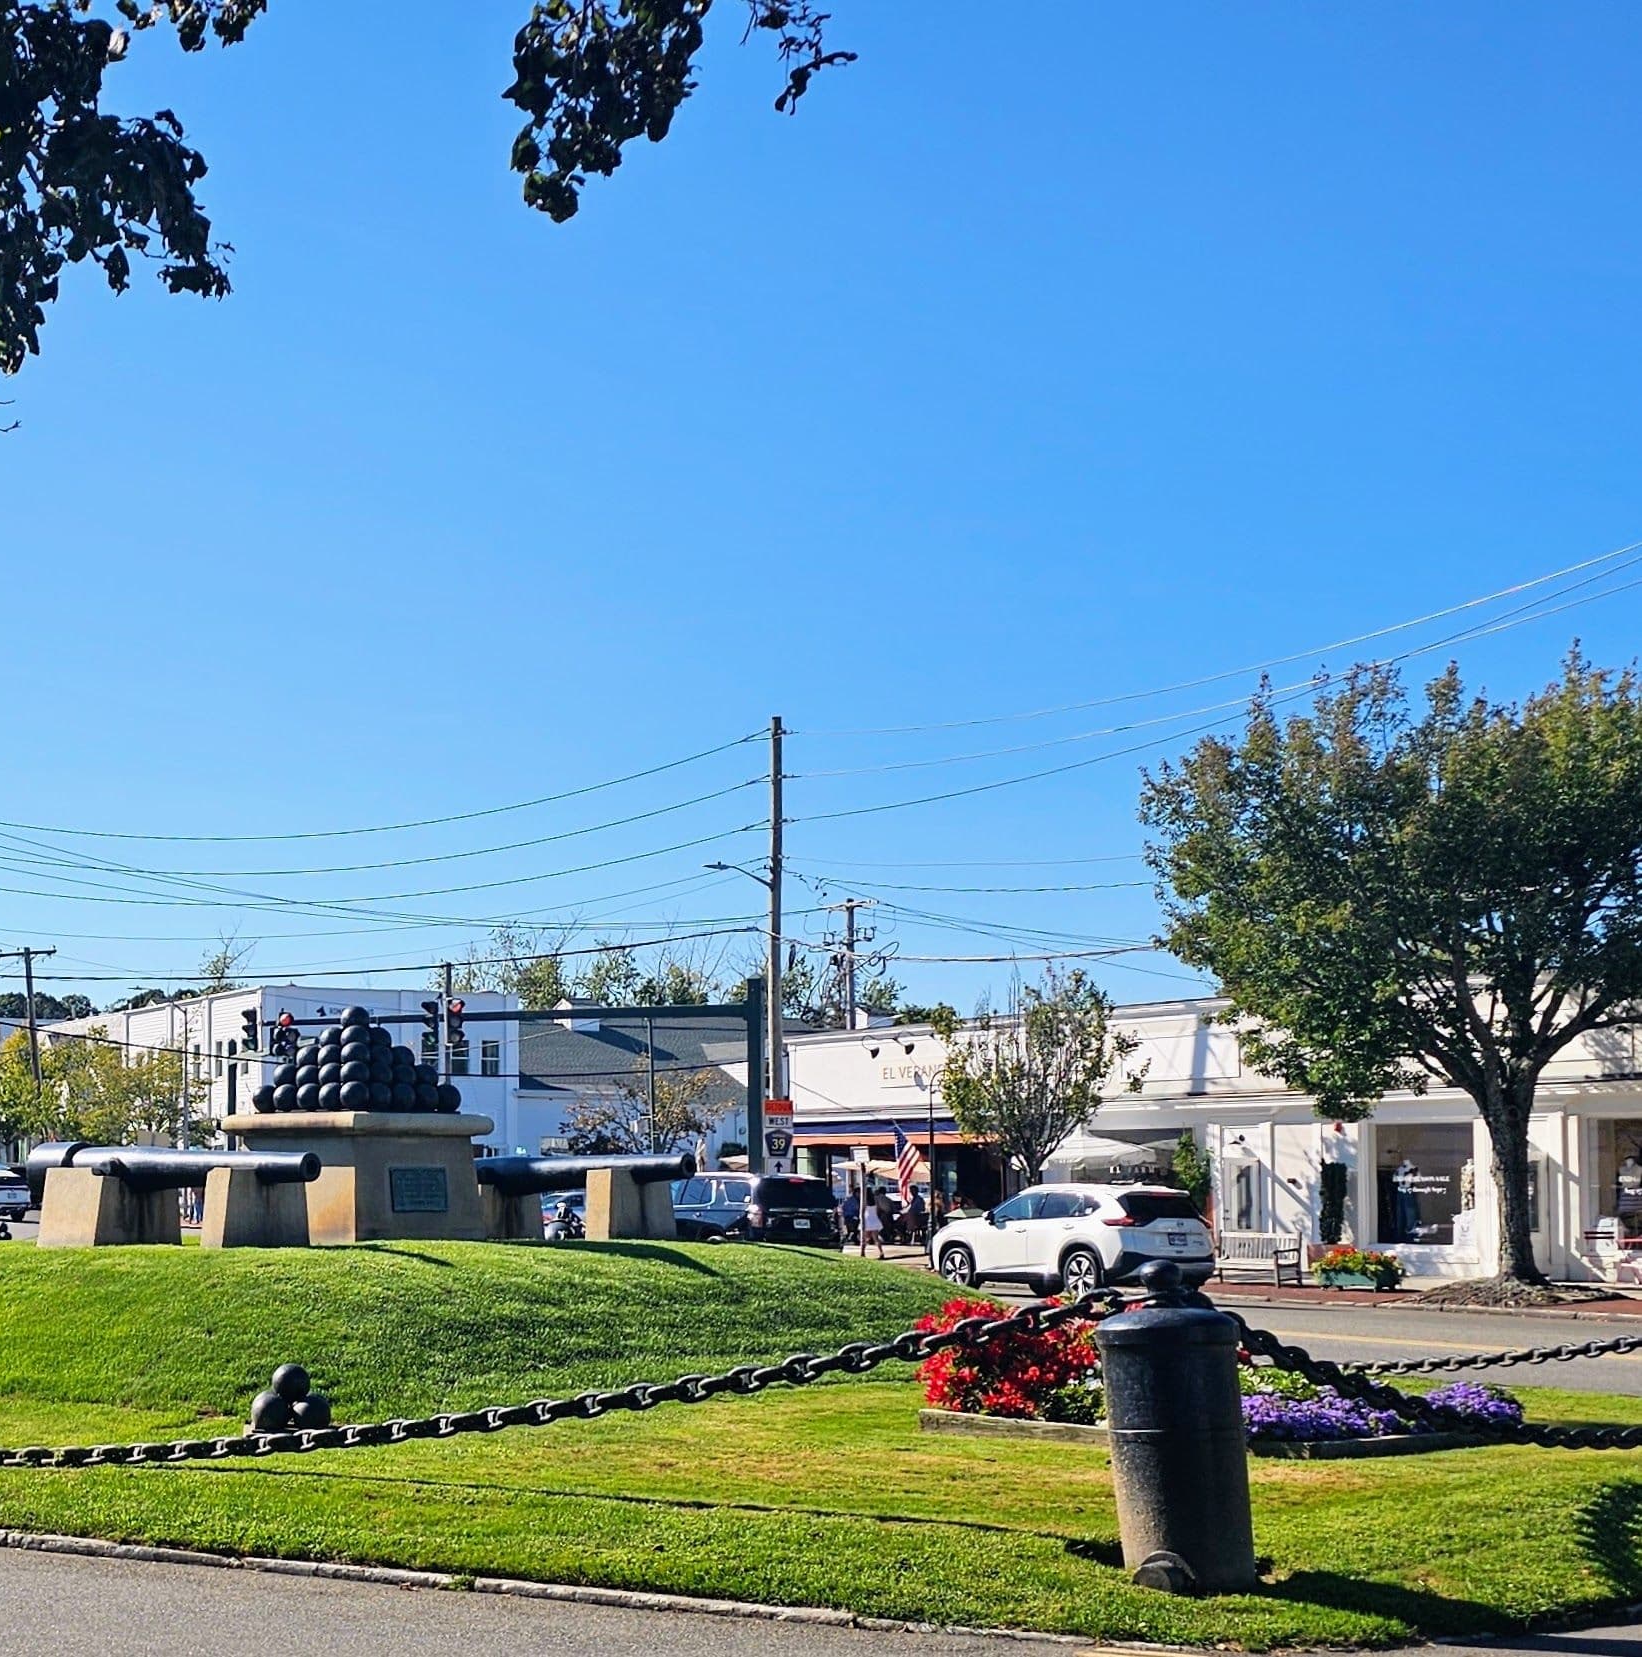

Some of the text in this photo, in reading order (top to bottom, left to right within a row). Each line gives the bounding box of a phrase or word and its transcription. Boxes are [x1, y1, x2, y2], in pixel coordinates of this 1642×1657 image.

[882, 1067, 896, 1080] EL
[769, 1117, 789, 1126] WEST
[771, 1138, 786, 1150] 39
